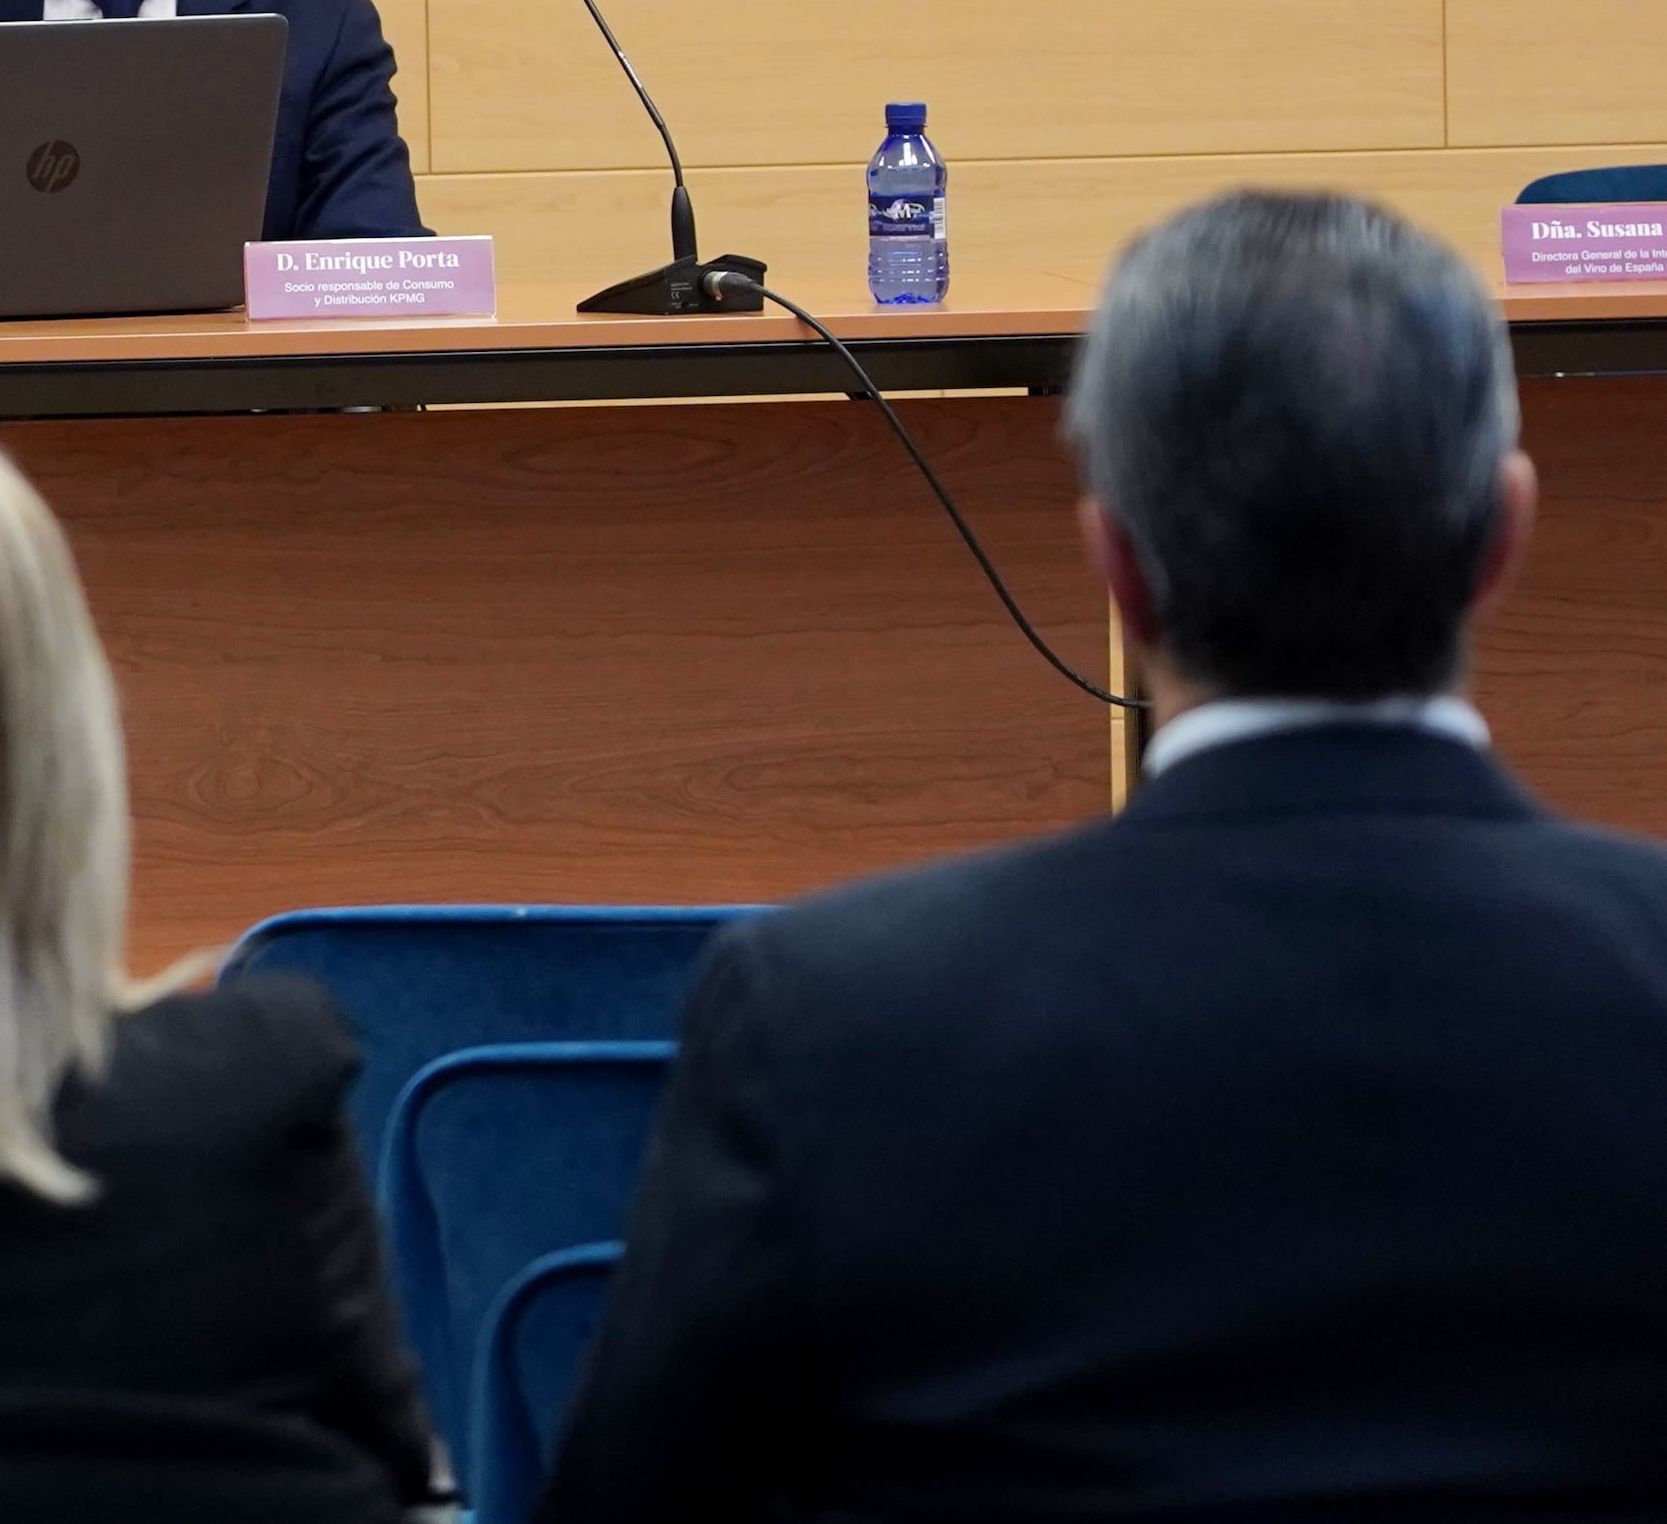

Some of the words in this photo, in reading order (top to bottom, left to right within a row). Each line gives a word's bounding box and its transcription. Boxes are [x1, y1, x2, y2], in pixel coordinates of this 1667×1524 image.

[1531, 220, 1582, 239] Dña.
[1587, 221, 1663, 238] Susana
[277, 253, 299, 271] D.
[305, 252, 394, 274] Enrique
[398, 250, 460, 268] Porta
[1532, 252, 1579, 262] Directora
[1581, 250, 1622, 260] General
[1624, 250, 1637, 259] de
[1640, 248, 1650, 258] la
[1565, 264, 1581, 274] del
[1583, 263, 1607, 273] Vino
[1609, 263, 1622, 273] de
[1625, 262, 1664, 274] España
[284, 282, 315, 292] Socio
[318, 280, 383, 292] responsable
[385, 280, 400, 290] de
[402, 279, 455, 290] Consumo
[314, 297, 321, 307] y
[324, 294, 387, 305] Distribución
[389, 292, 426, 304] KPMG
